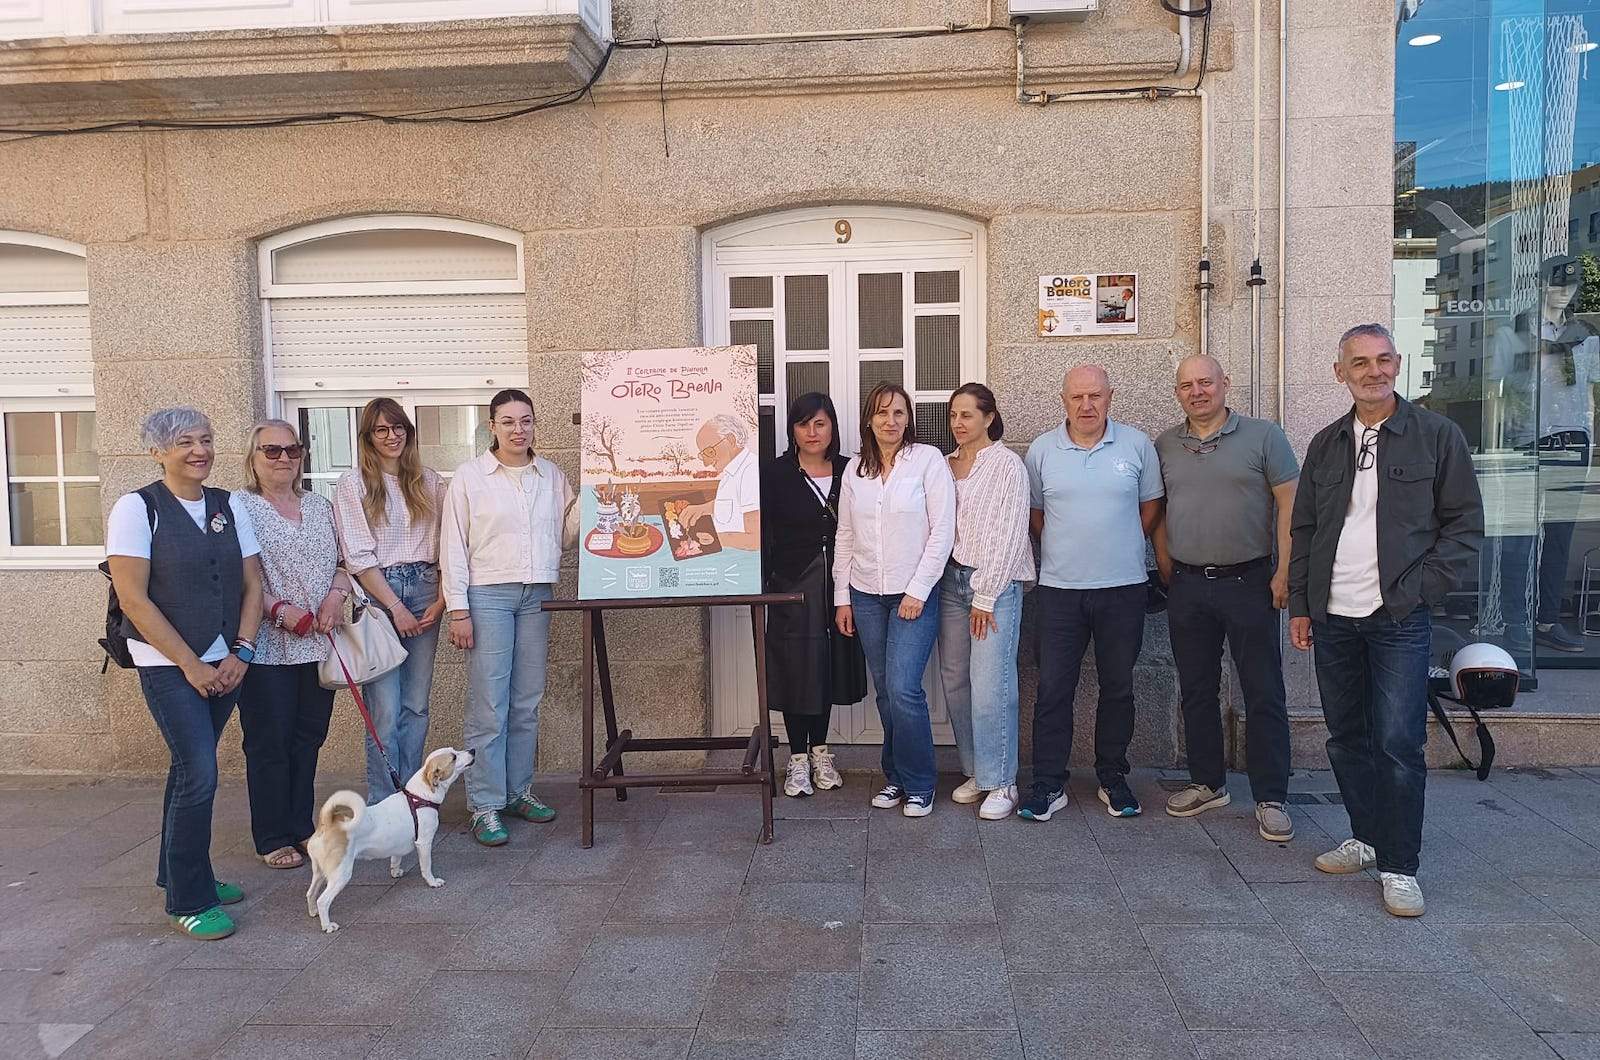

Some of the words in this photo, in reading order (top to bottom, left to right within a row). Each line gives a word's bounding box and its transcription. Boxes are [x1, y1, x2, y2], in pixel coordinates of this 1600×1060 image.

[835, 220, 851, 243] 9
[1052, 277, 1091, 287] Otero
[1047, 286, 1090, 297] Baena
